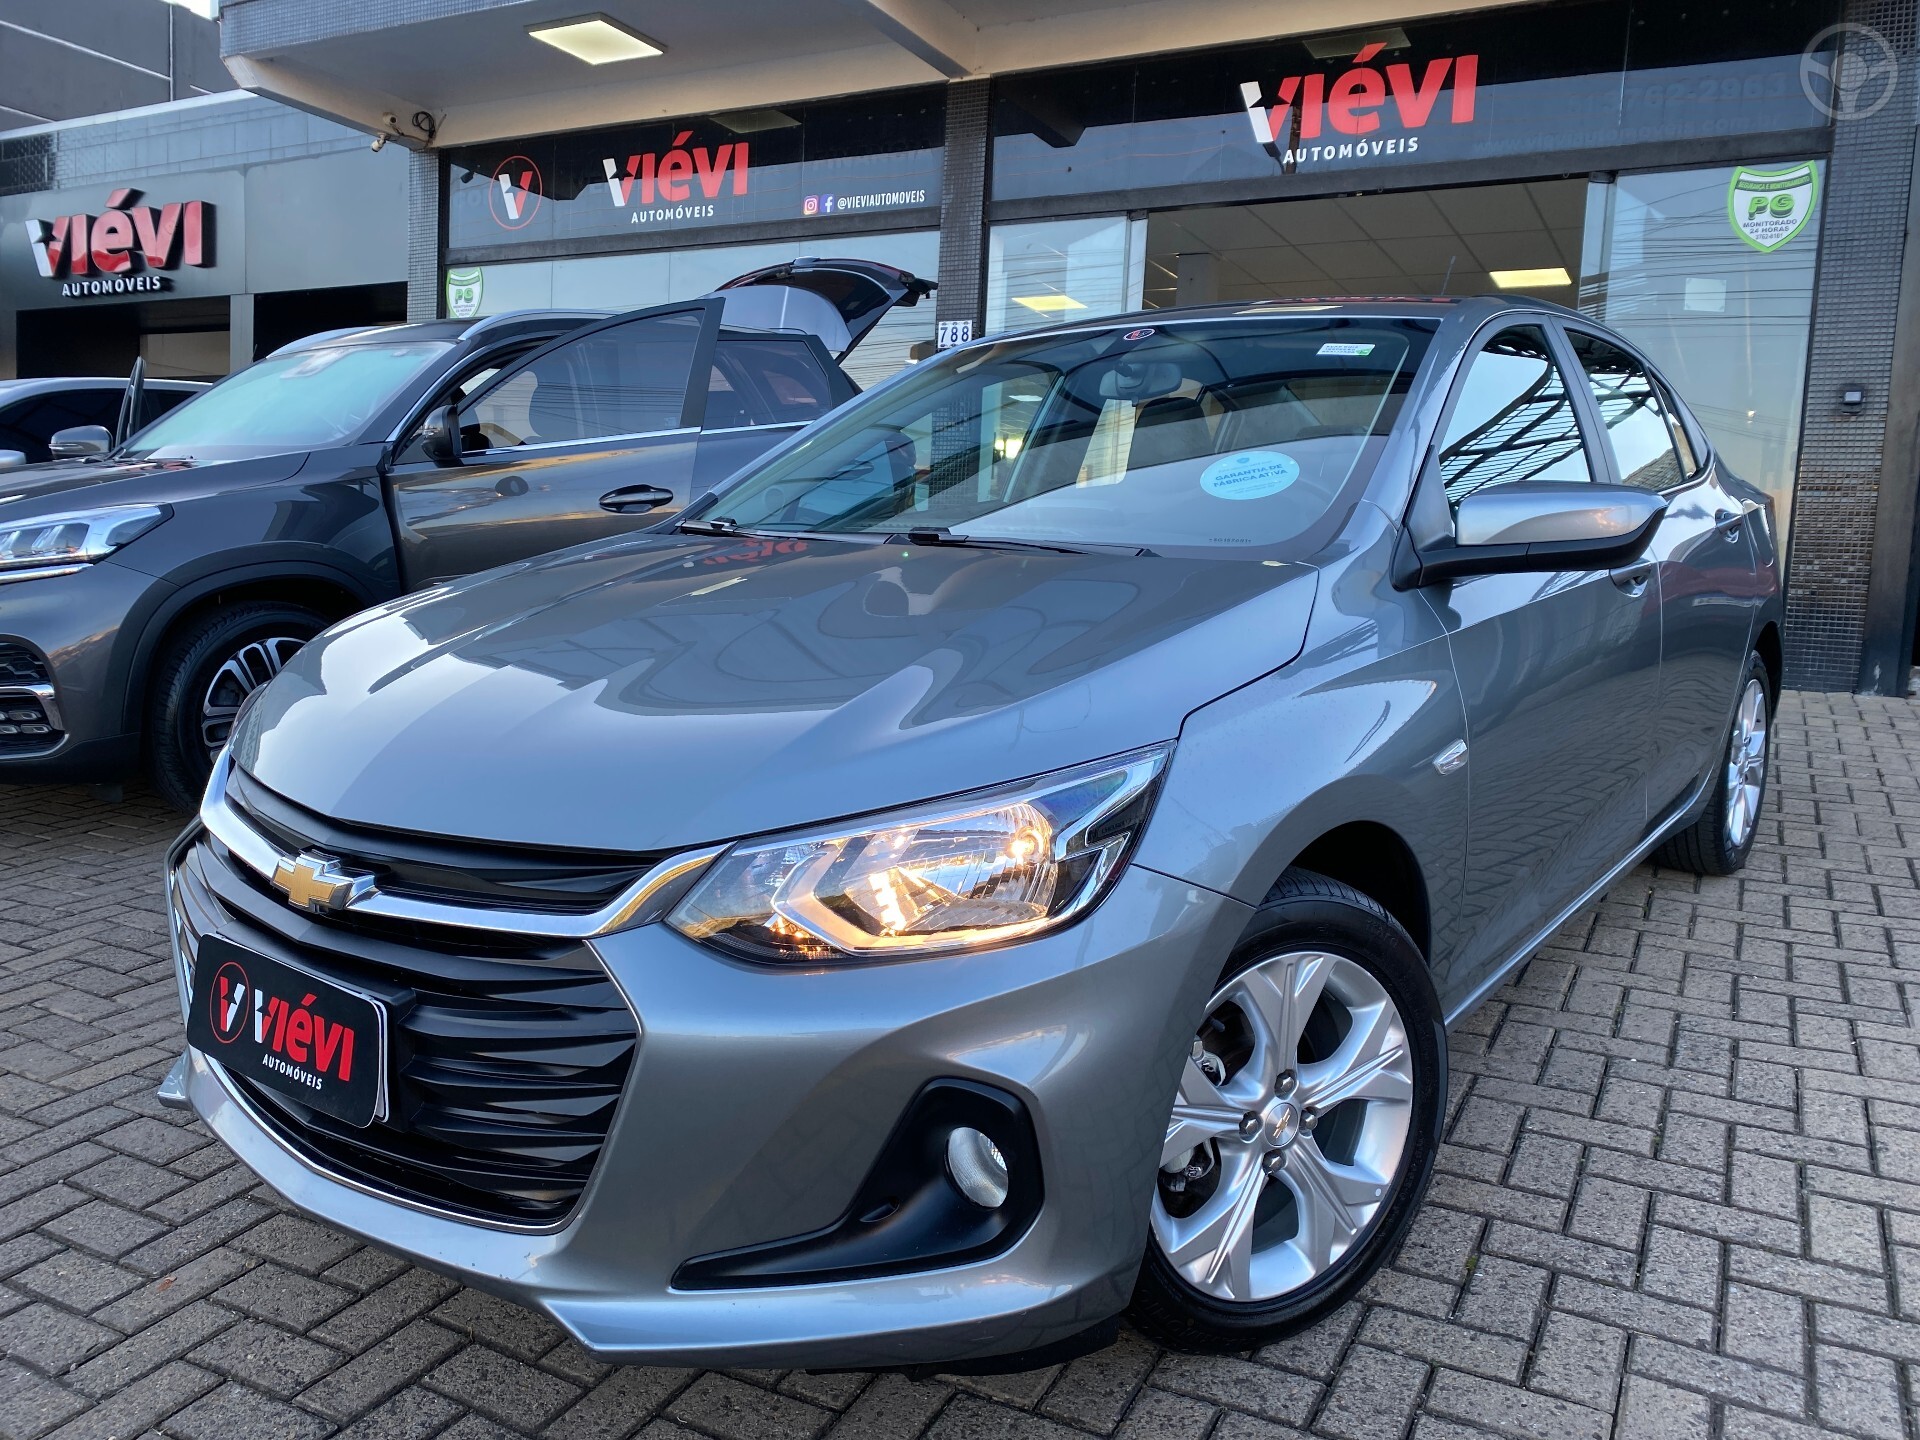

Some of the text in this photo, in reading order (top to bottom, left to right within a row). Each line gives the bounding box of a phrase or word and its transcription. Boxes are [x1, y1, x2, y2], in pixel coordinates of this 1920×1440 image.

[1283, 136, 1419, 164] AUTOMÓVEIS
[837, 189, 925, 210] @VIEVIAUTOMOVEIS
[631, 202, 714, 224] AUTOMÓVEIS
[1743, 219, 1798, 228] MONITORADO
[62, 275, 161, 297] AUTOMÓVEIS
[940, 325, 969, 343] 788
[1215, 467, 1267, 480] GARANTIA
[1258, 469, 1288, 479] ATIVA
[262, 1053, 323, 1090] AUTOMÓVEIS
